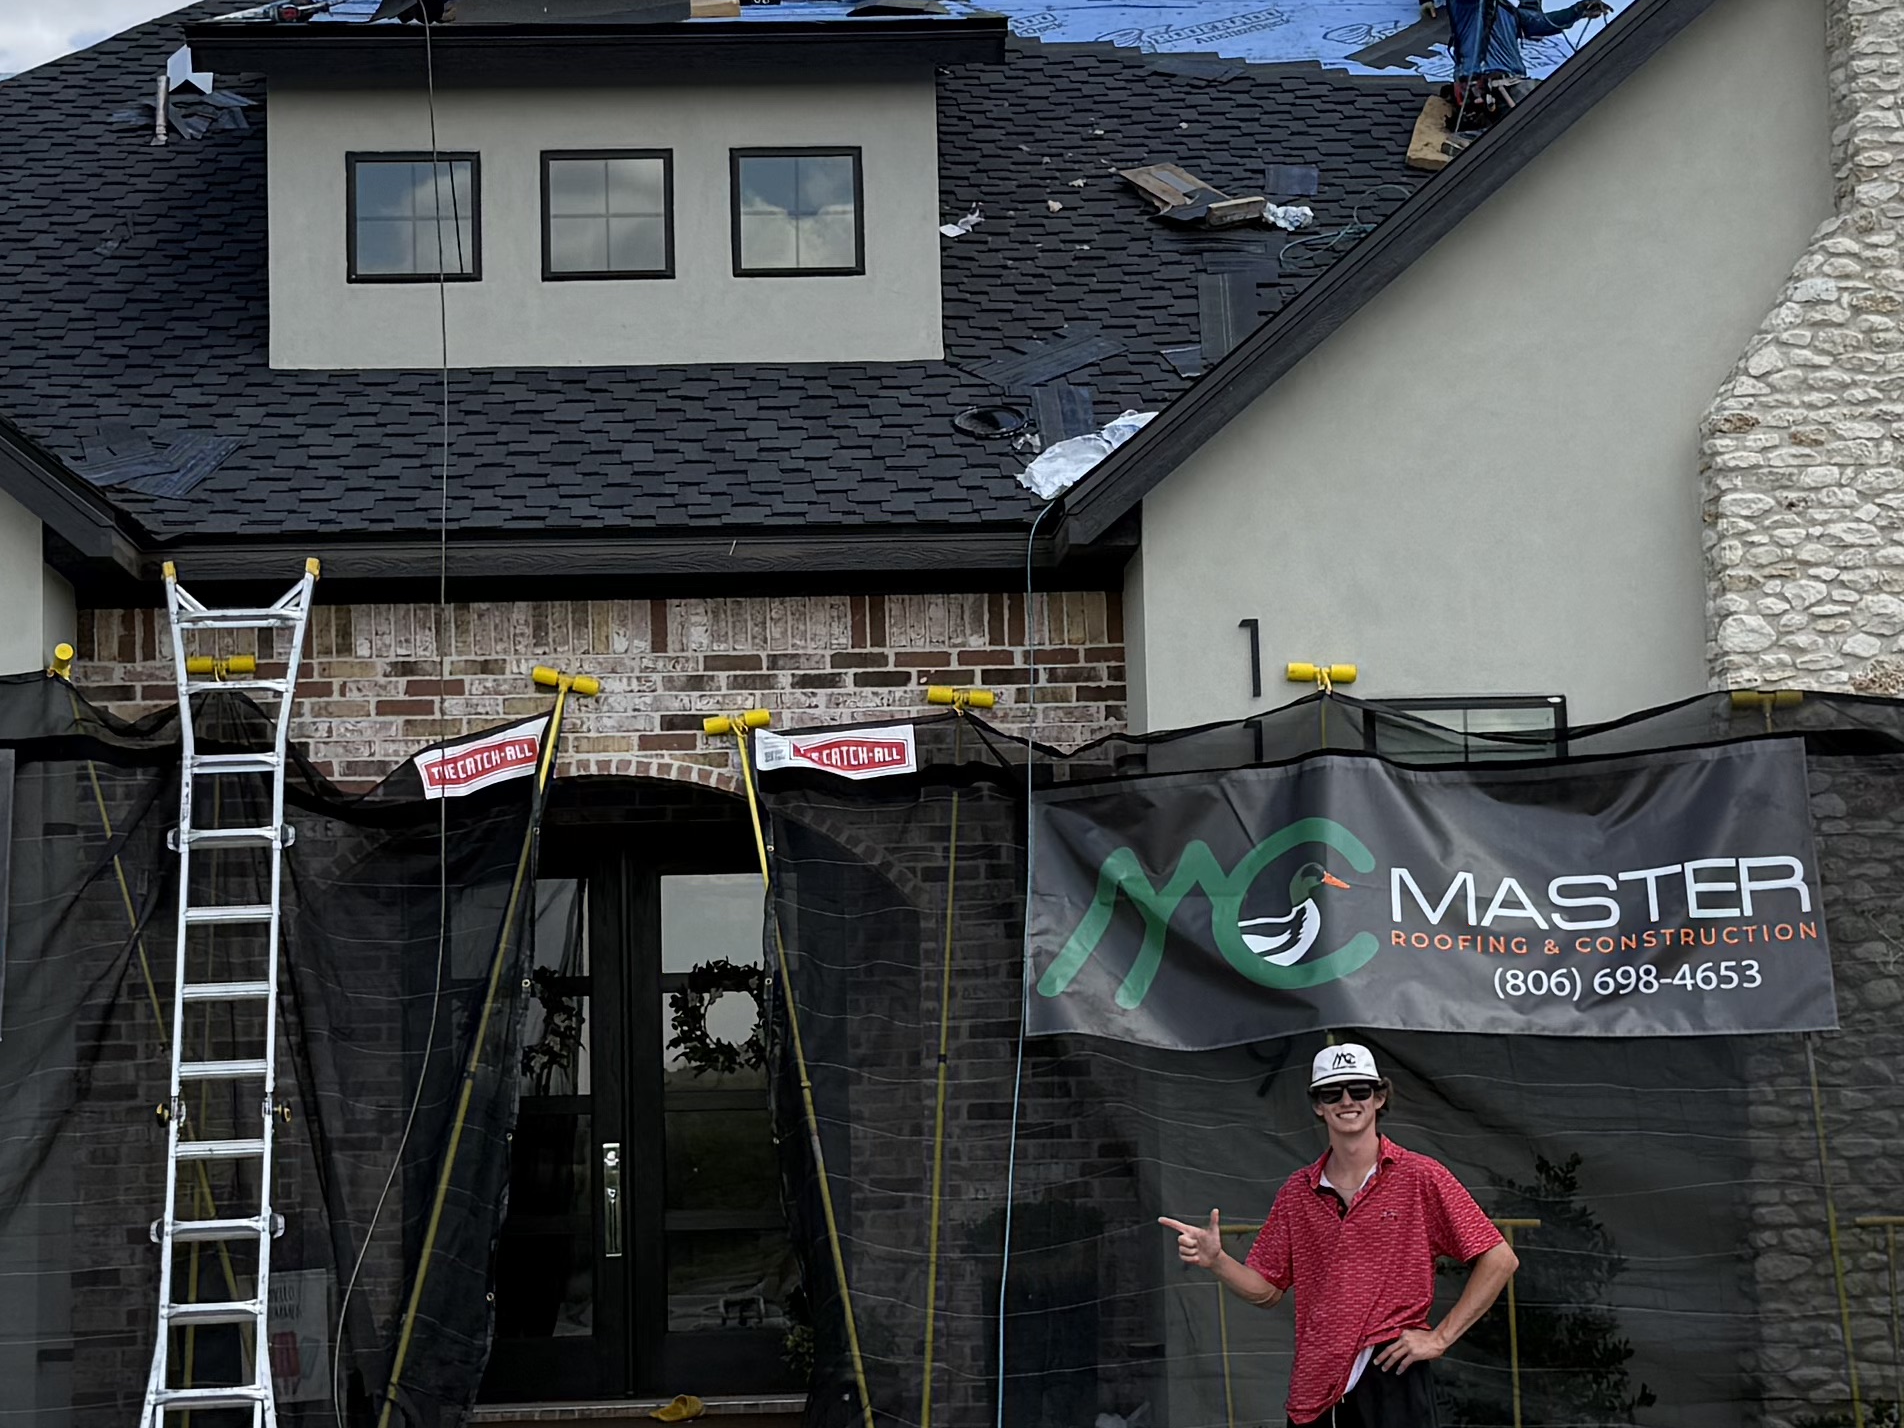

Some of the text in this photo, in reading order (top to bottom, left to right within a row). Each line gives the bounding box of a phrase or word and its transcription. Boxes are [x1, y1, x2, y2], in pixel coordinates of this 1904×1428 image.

[1391, 856, 1811, 931] MASTER
[1391, 922, 1818, 955] ROOFING & CONSTRUCTION
[1493, 959, 1762, 1002] (806) 698-4653
